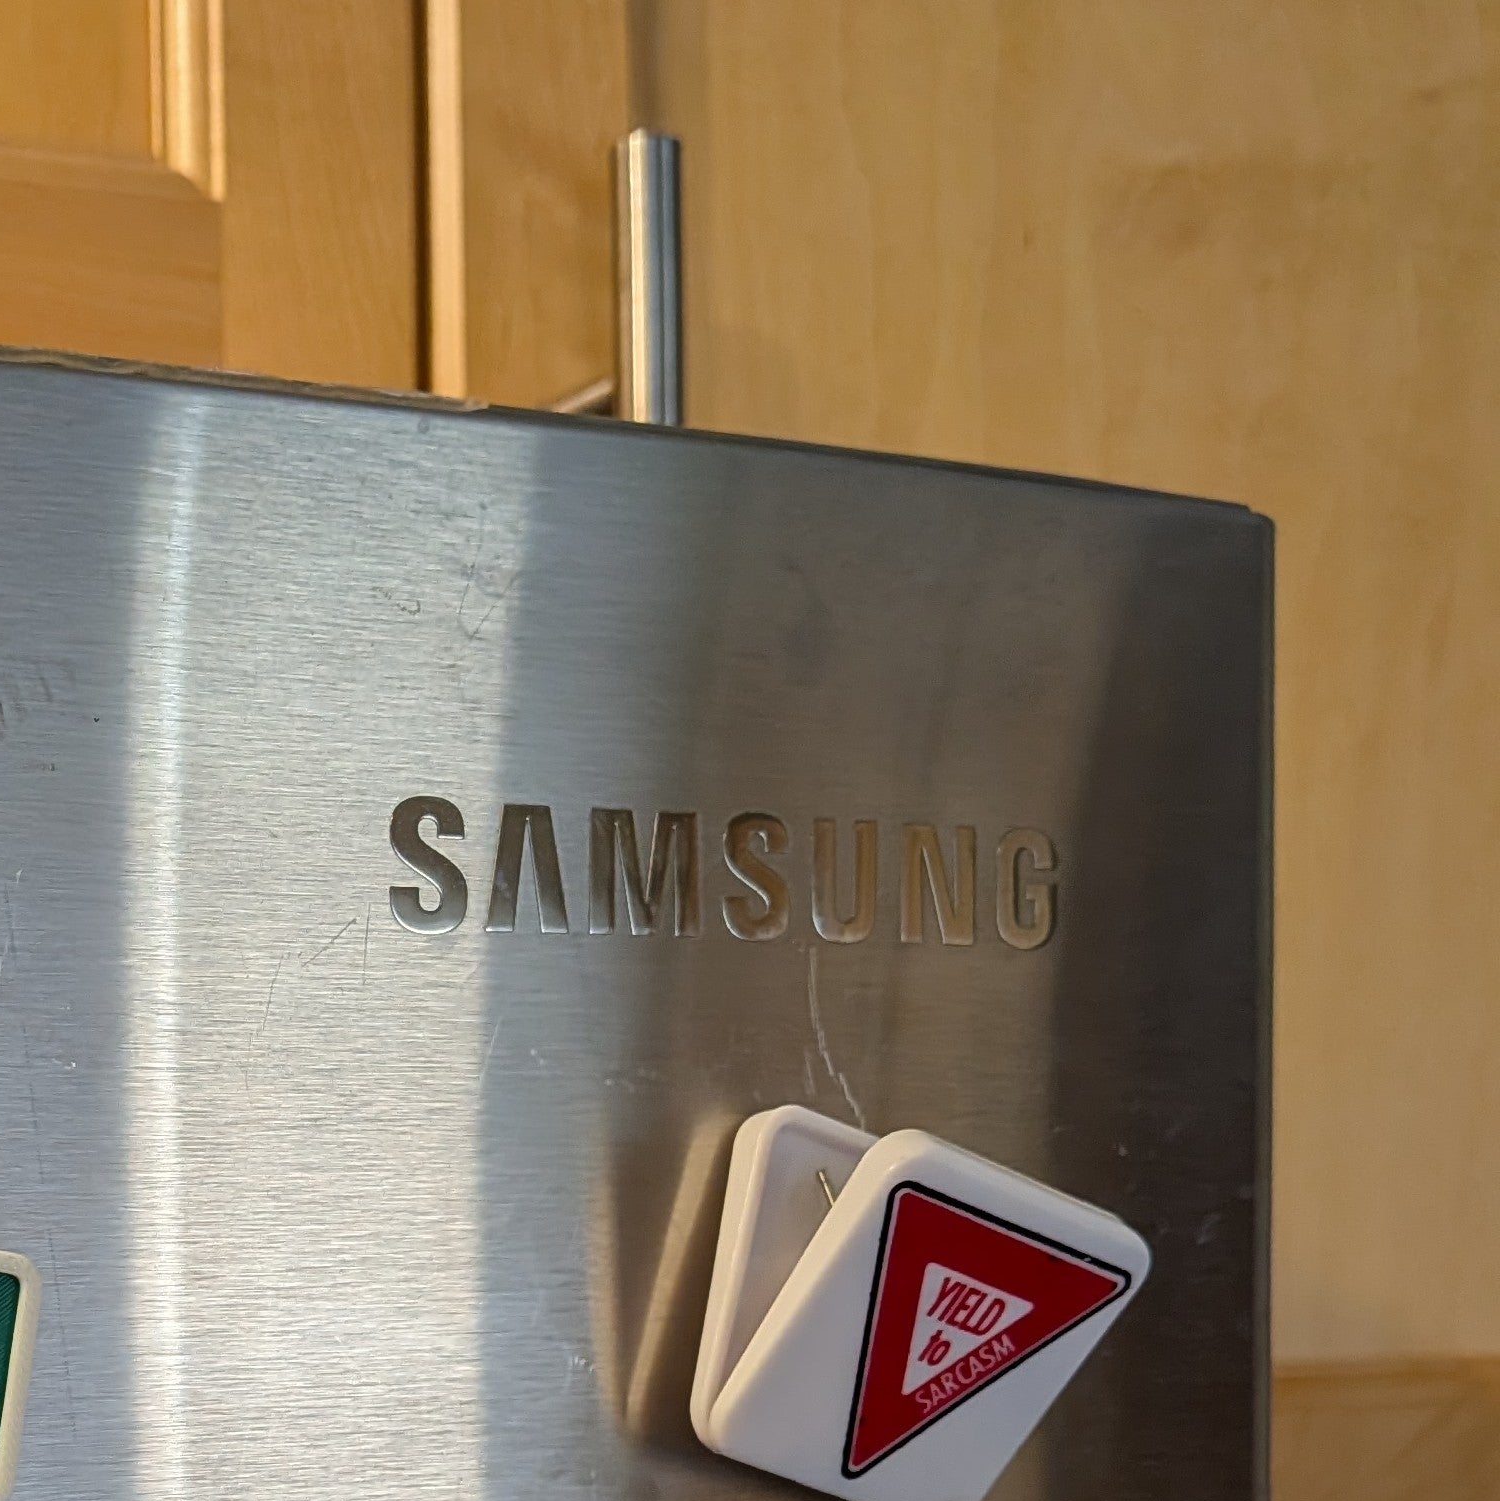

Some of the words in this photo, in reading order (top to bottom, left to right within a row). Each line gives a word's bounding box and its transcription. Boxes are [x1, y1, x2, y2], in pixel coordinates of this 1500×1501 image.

[389, 795, 1057, 950] SAMSUNG
[926, 1275, 1007, 1337] YIELD
[914, 1333, 1016, 1414] SARCASM
